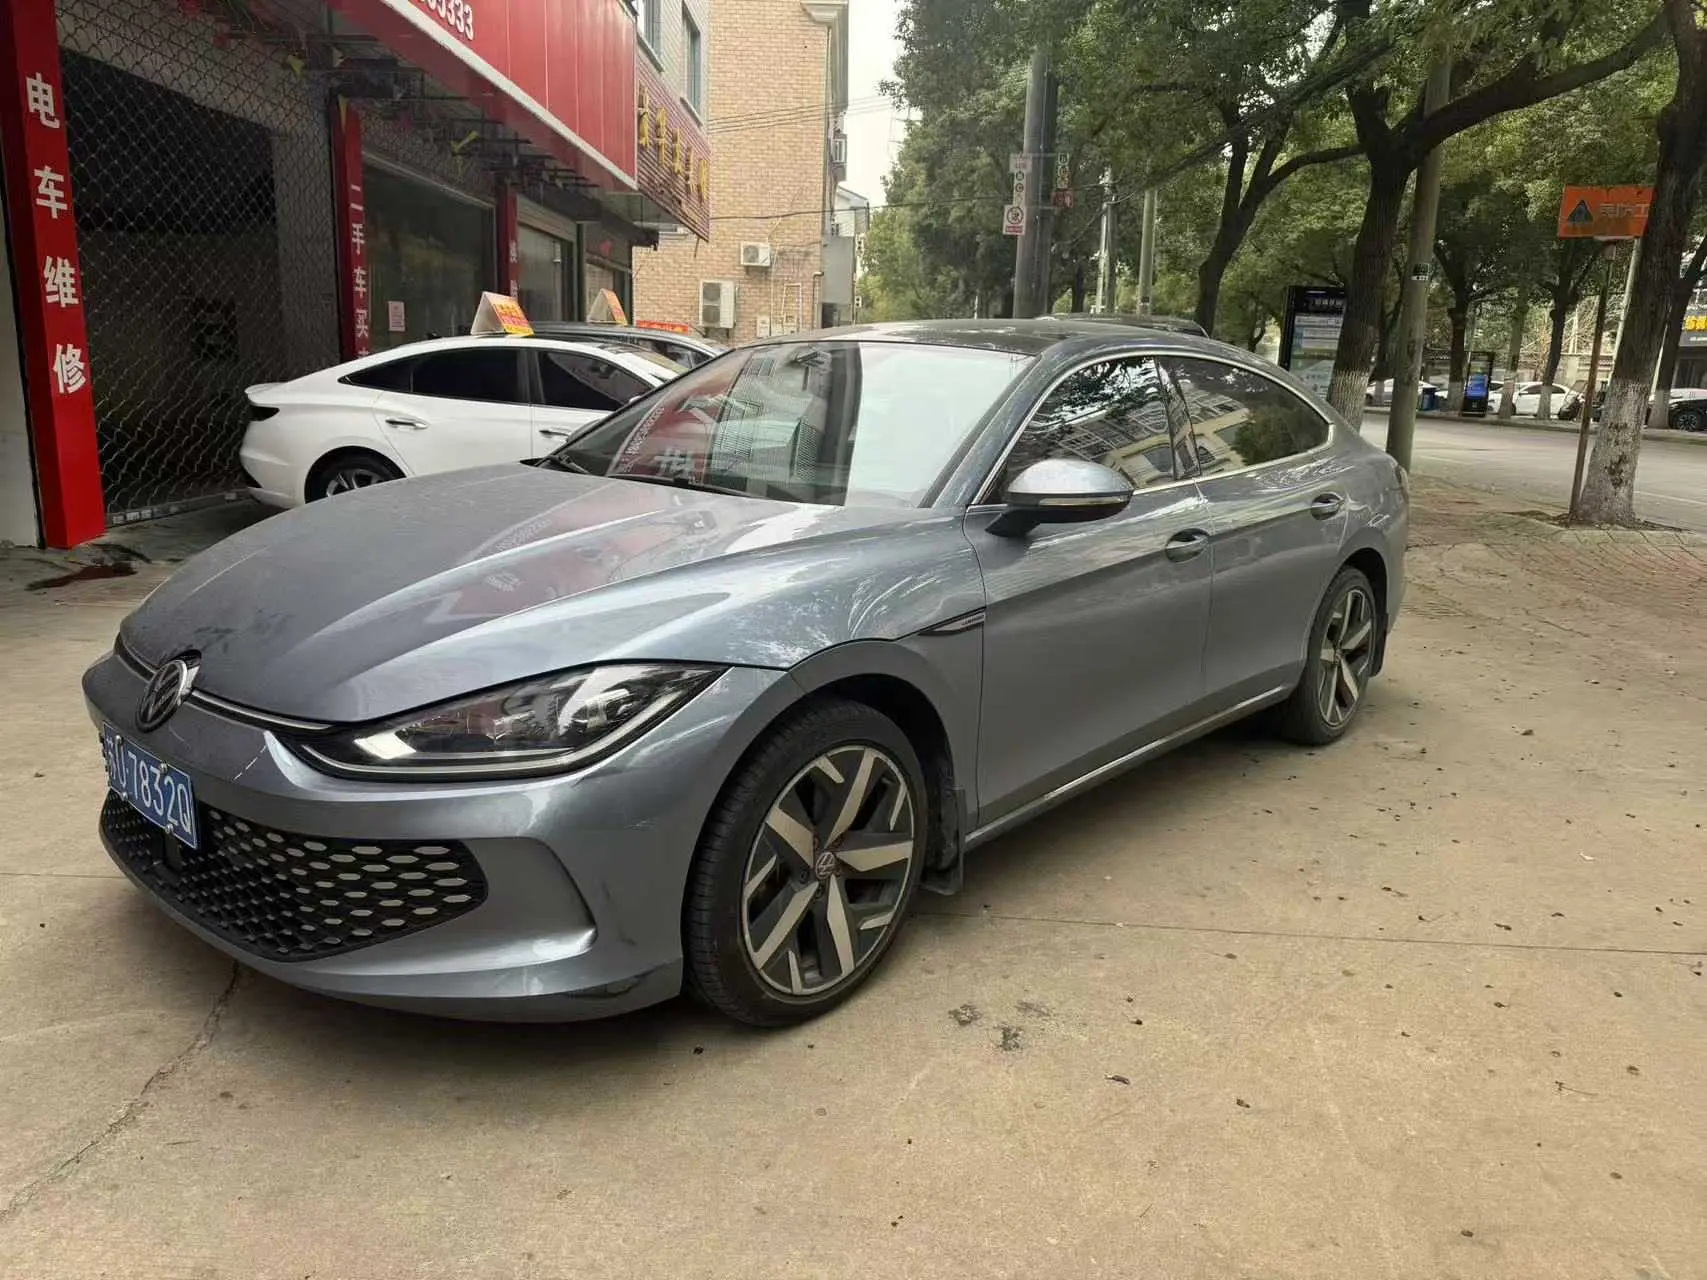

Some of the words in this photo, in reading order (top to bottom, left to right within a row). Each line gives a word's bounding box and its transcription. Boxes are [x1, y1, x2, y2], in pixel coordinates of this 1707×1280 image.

[26, 72, 86, 394] 电车维修
[350, 184, 370, 357] 二手车买
